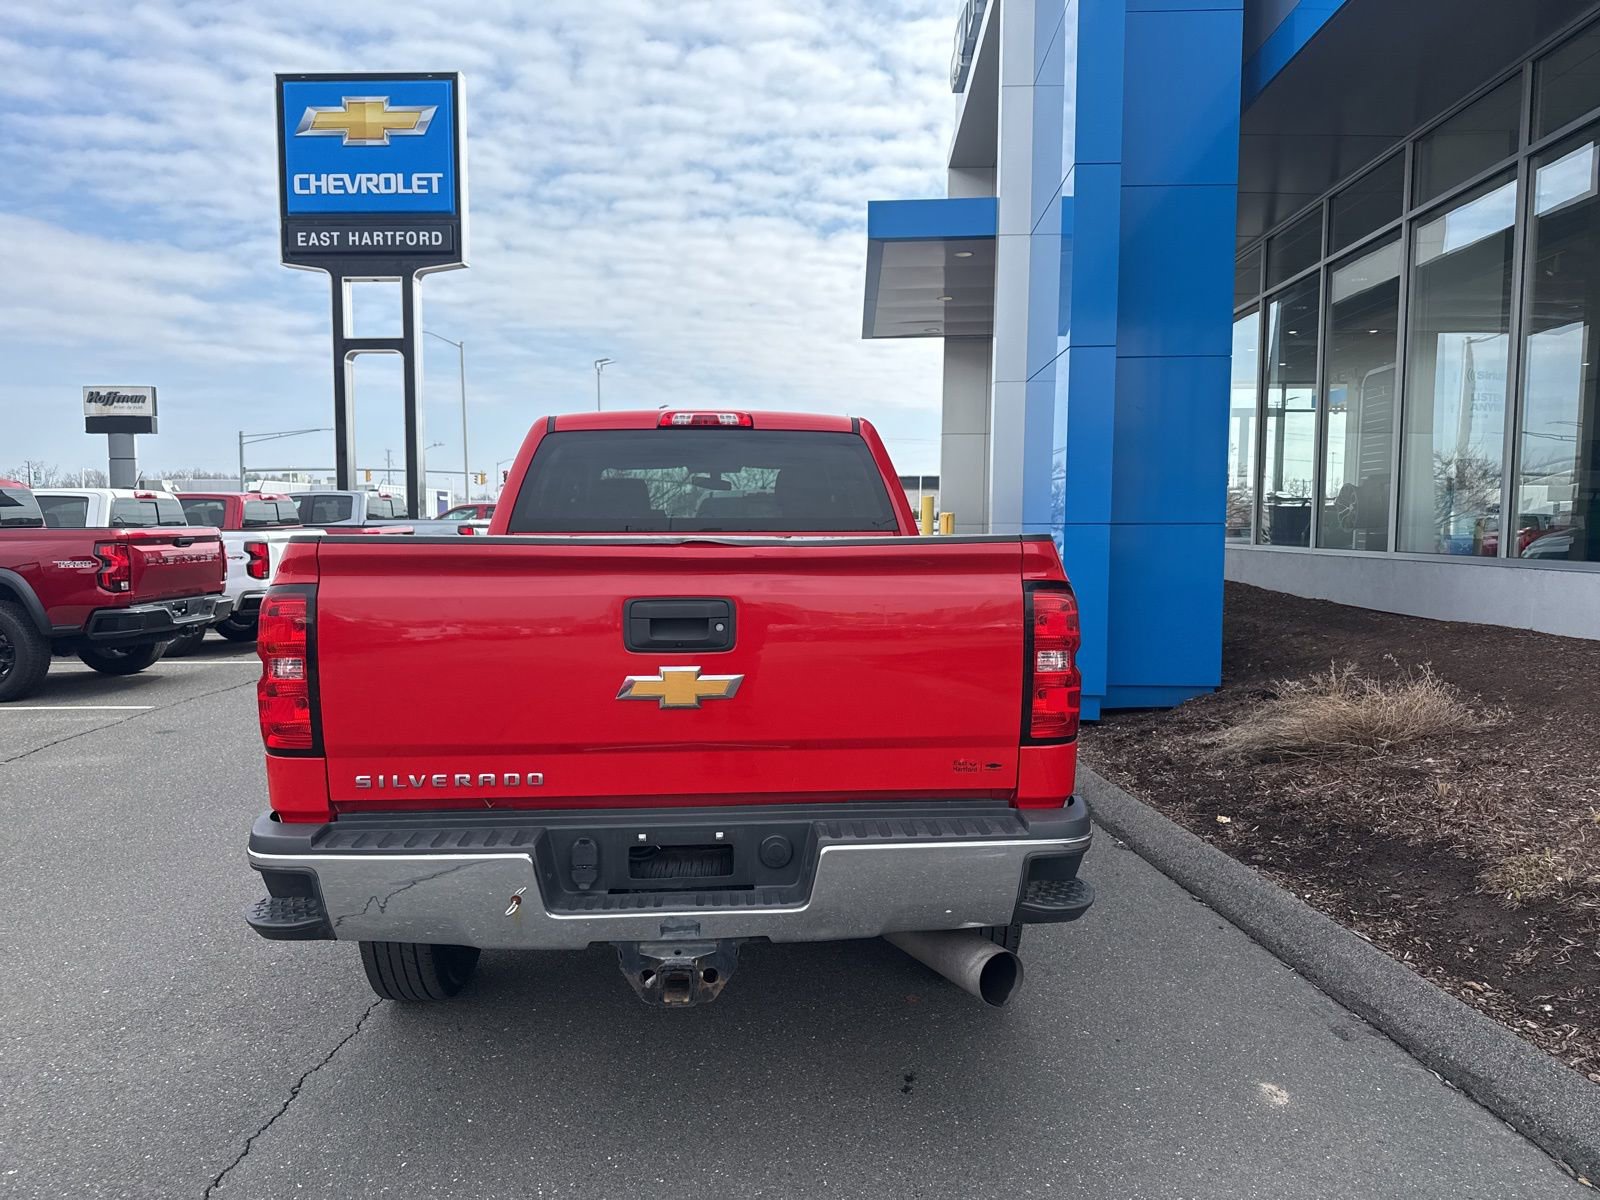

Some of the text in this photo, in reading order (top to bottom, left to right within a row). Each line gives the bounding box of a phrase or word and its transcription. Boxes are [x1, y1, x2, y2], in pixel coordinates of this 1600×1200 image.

[293, 173, 443, 195] CHEVROLET
[296, 230, 443, 246] EAST HARTFORD
[86, 391, 147, 406] Hoffman
[354, 772, 544, 789] SILVERADO
